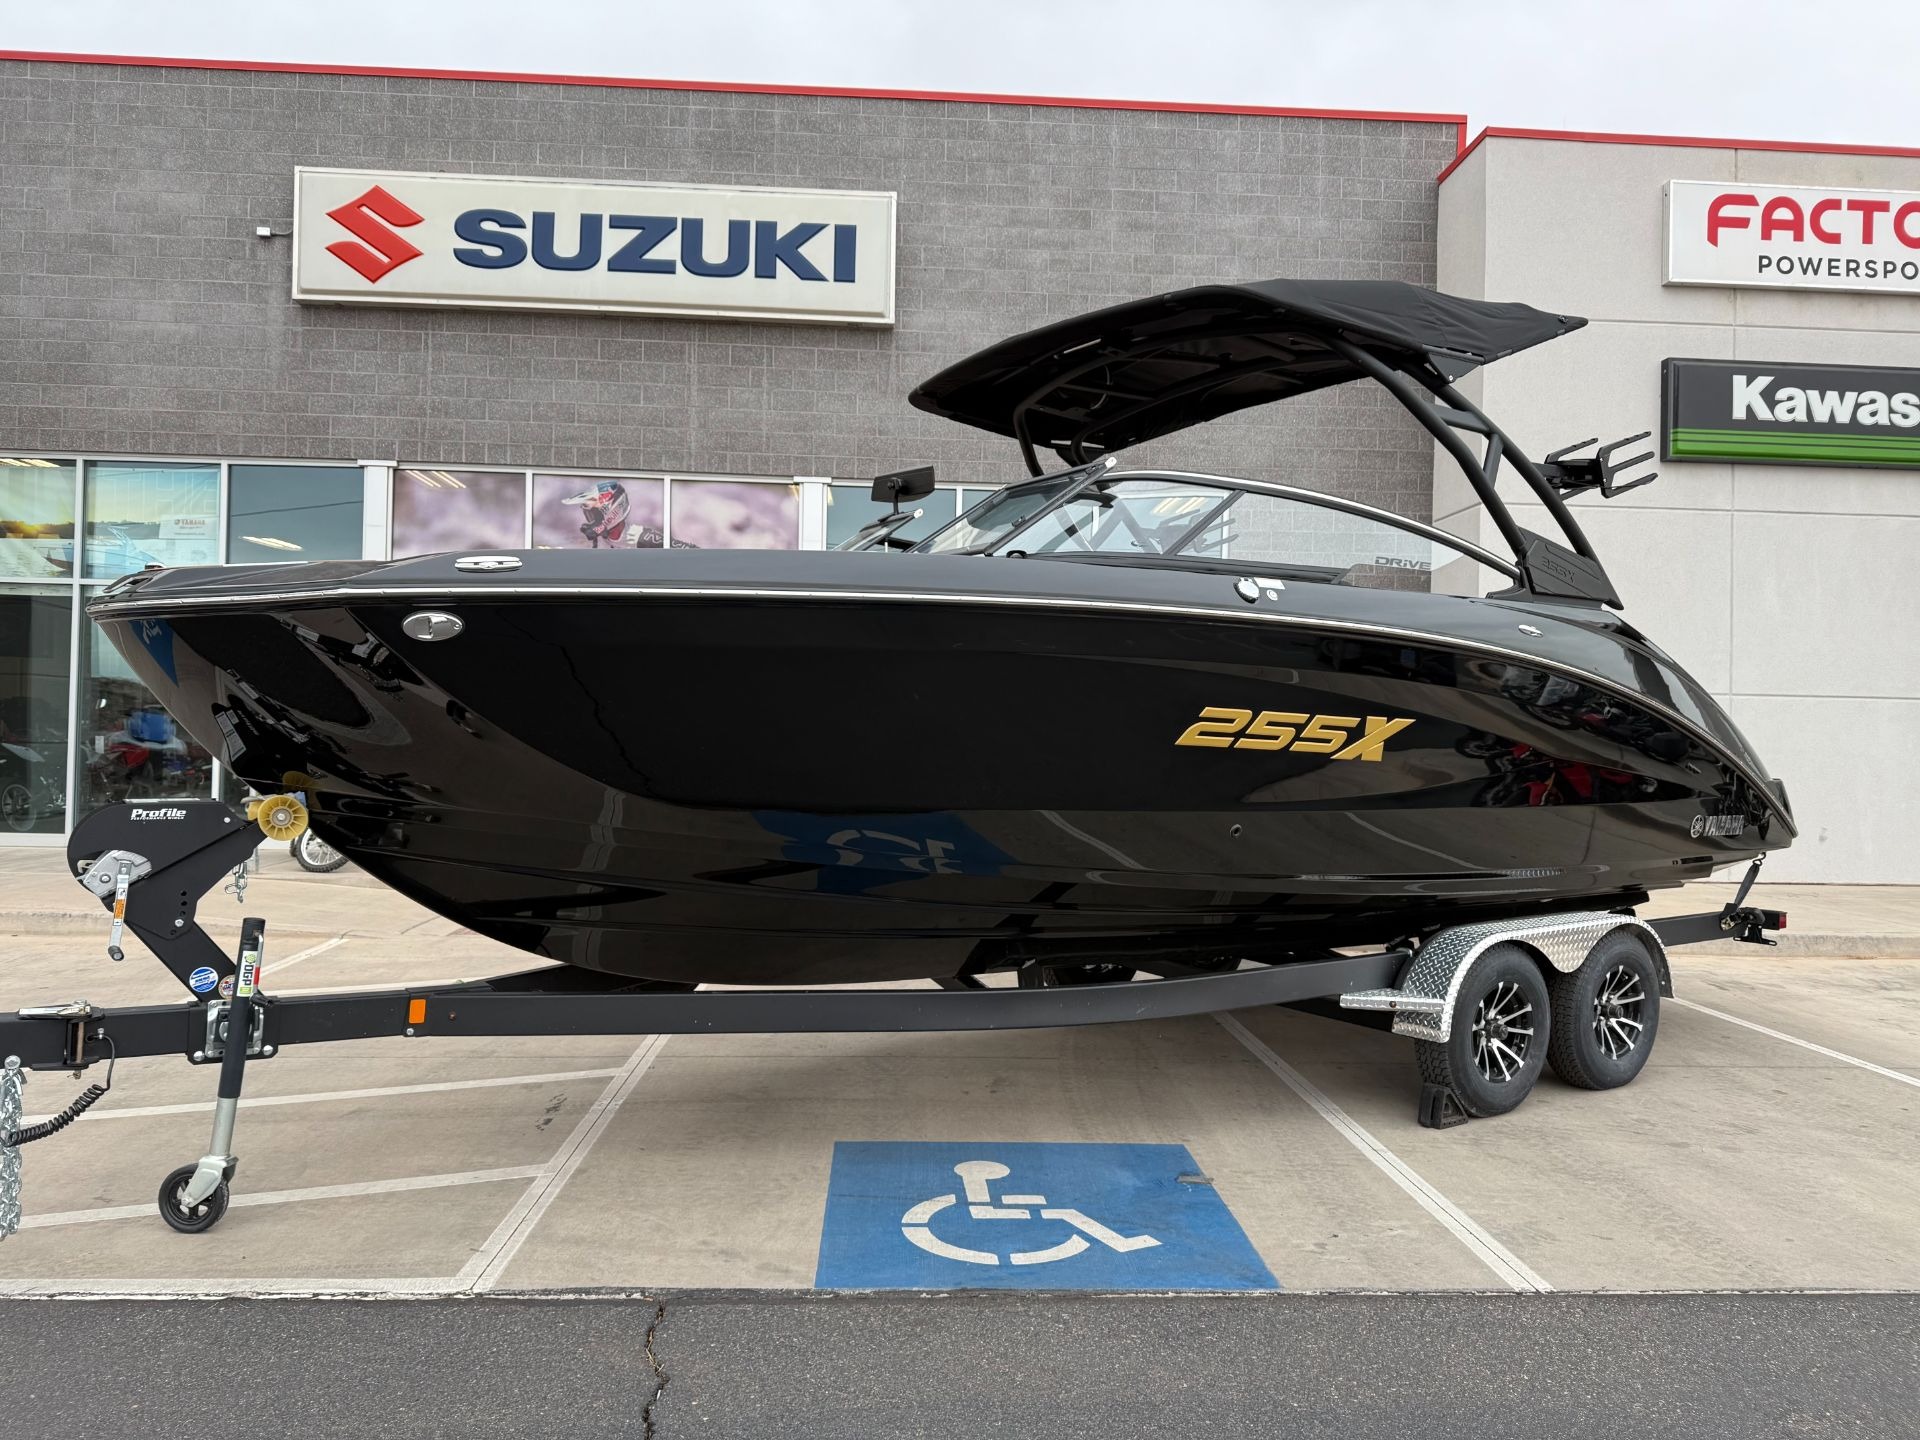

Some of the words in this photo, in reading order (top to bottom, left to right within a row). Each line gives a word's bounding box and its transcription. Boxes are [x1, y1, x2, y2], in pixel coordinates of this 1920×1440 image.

[453, 208, 857, 283] SUZUKI
[1758, 255, 1919, 280] POWERSPO
[1732, 375, 1920, 428] Kawas
[1174, 706, 1416, 762] 255X
[131, 808, 187, 817] Profile
